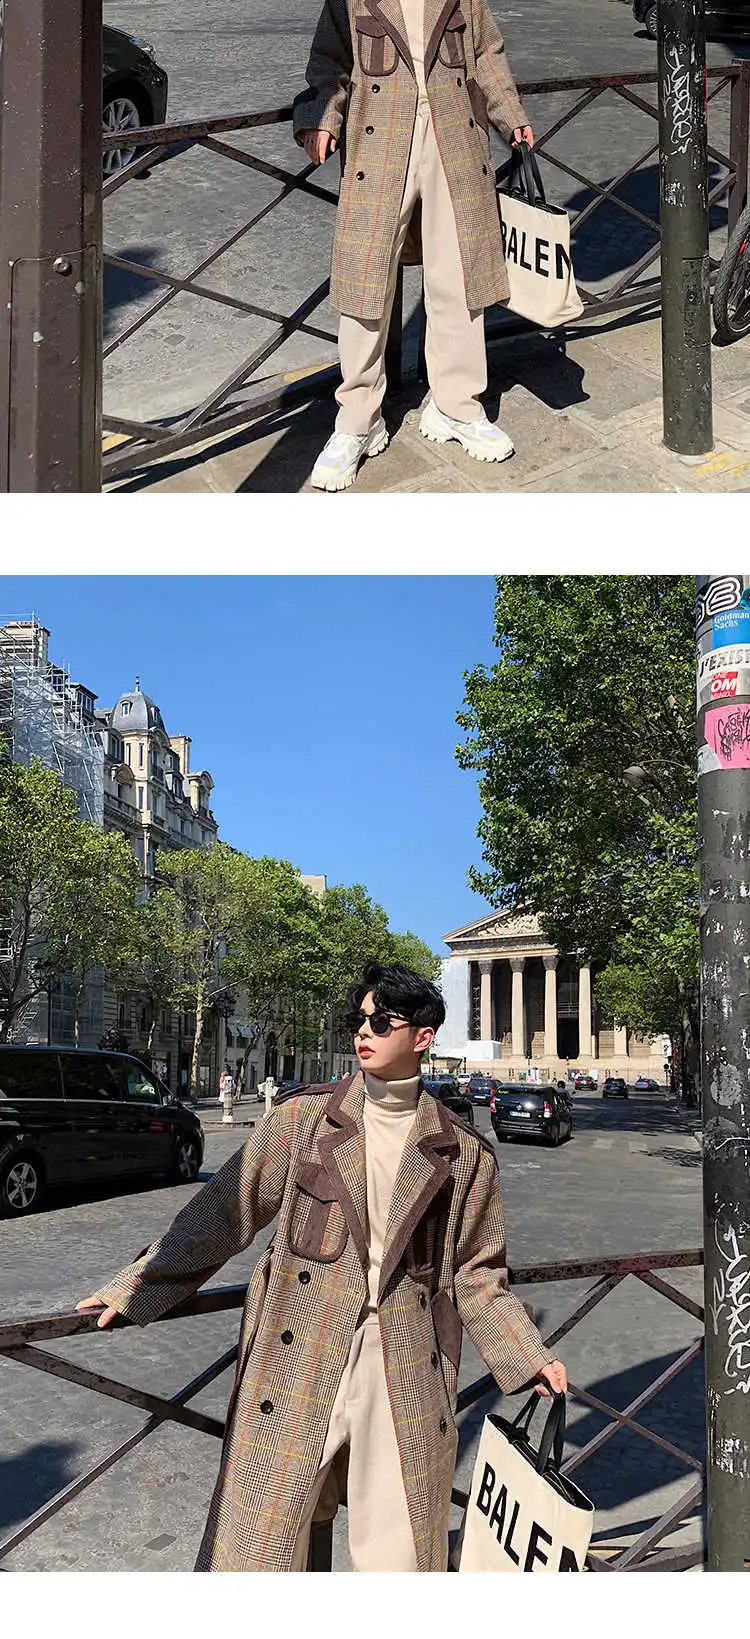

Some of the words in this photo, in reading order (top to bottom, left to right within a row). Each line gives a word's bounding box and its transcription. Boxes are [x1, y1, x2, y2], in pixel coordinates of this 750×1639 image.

[713, 612, 750, 625] Goldman
[714, 619, 738, 630] Sachs
[711, 677, 737, 691] OM
